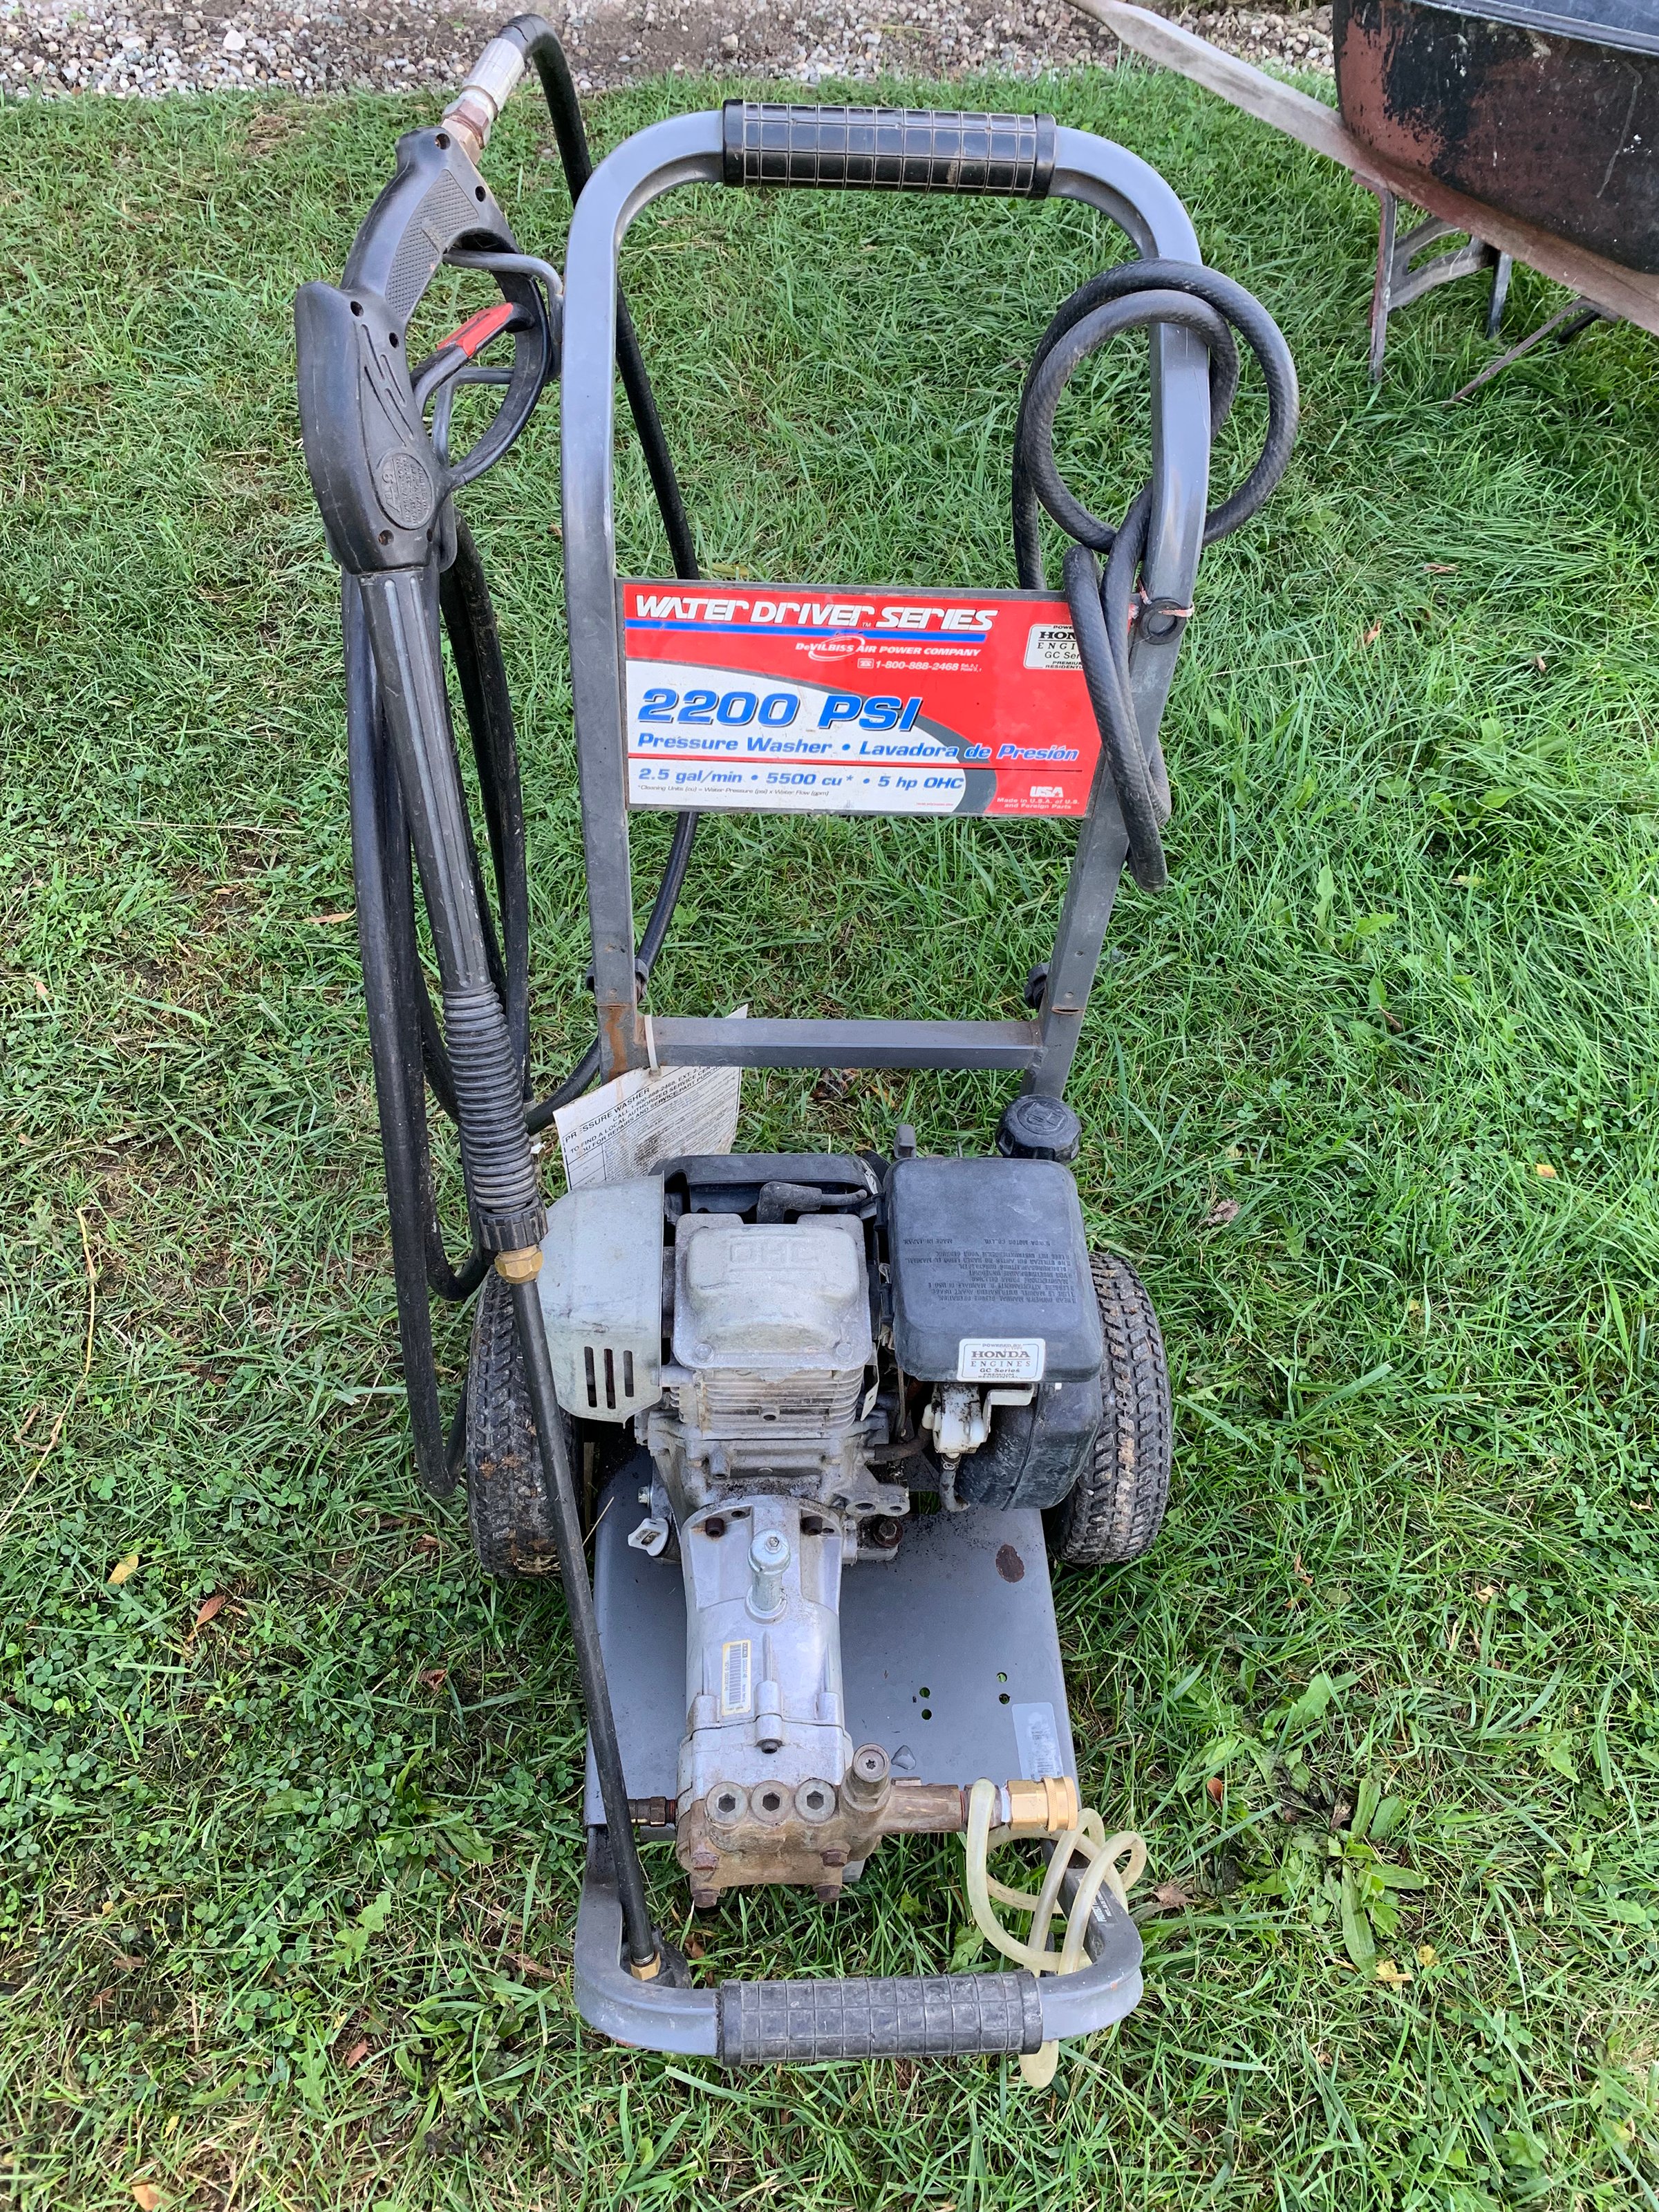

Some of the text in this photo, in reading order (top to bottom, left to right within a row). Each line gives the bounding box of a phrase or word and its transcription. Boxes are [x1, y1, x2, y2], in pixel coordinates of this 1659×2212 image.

[635, 594, 749, 621] WATER
[750, 601, 874, 627] DRIVER
[875, 606, 998, 631] SERIES
[1038, 631, 1076, 640] HON
[795, 643, 982, 657] DeVILBISS AIR POWER COMPANY
[1063, 651, 1080, 659] Ser
[876, 660, 959, 671] 1-800-888-2468
[637, 688, 924, 732] 2200 PSI
[637, 732, 1079, 761] Pressure Washer Lavadora de Presión
[639, 767, 670, 780] 2.5
[675, 770, 743, 785] gal/min
[766, 772, 817, 785] 5500
[877, 776, 890, 787] 5
[896, 777, 917, 791] hp
[924, 777, 964, 789] OHC
[1029, 785, 1064, 798] USA
[565, 1087, 650, 1143] PRSSURE WASHER
[570, 1145, 579, 1154] TO
[581, 1135, 597, 1147] FIND
[604, 1118, 625, 1134] LOCAL
[628, 1091, 668, 1118] AUTHORIZED
[669, 1075, 697, 1092] SERVICE
[592, 1137, 607, 1147] FOR
[608, 1117, 635, 1136] REPAIRS
[635, 1107, 649, 1118] AND
[650, 1091, 678, 1107] SERVICE
[679, 1080, 695, 1093] PART
[612, 1109, 629, 1122] CALL
